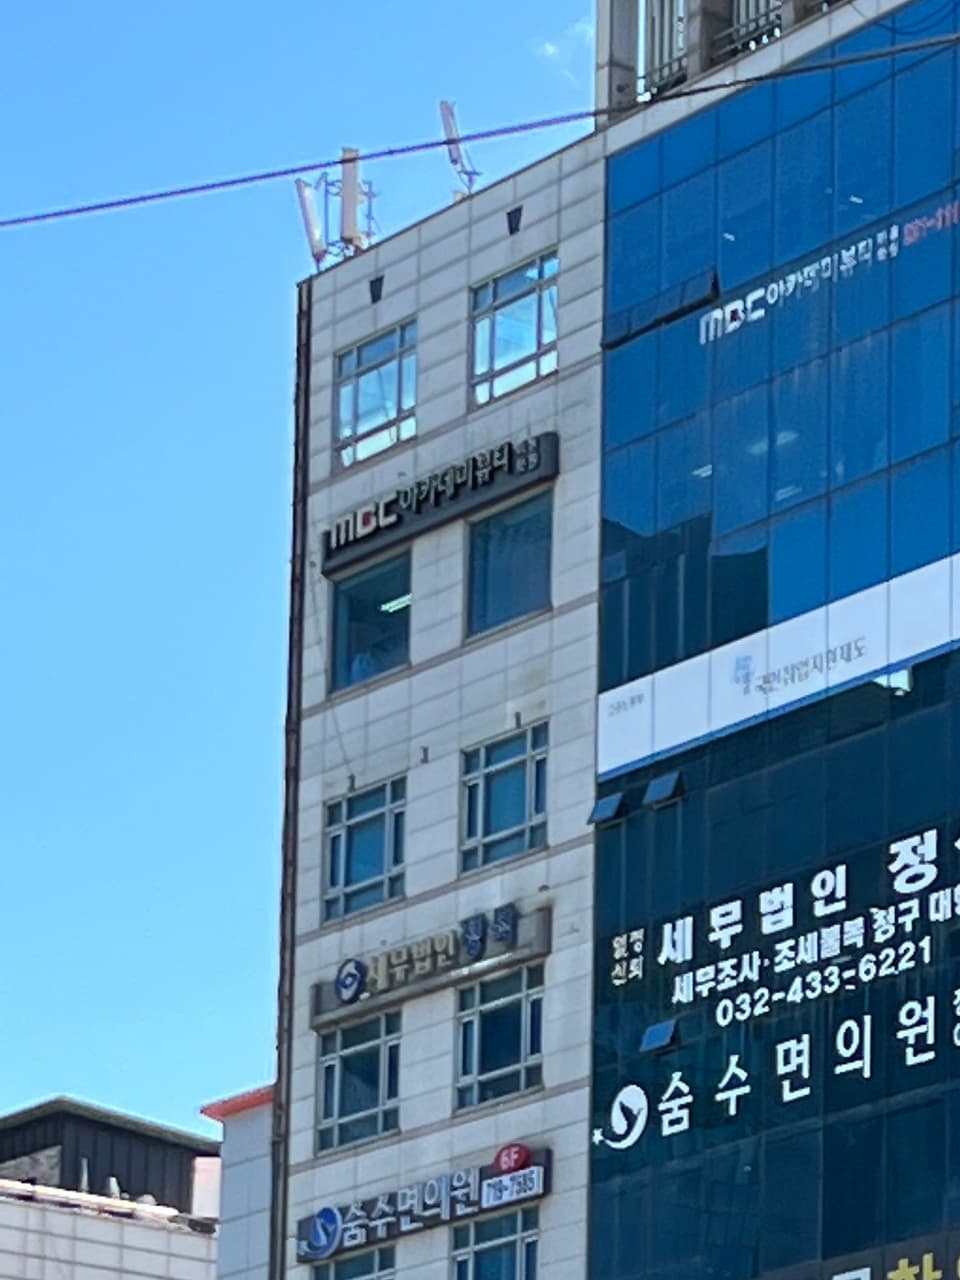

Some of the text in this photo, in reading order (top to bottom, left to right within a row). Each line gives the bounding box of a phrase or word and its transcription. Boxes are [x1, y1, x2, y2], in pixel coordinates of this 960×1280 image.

[657, 864, 847, 965] 세무법인
[715, 936, 933, 1027] 032-433-6221
[657, 996, 936, 1137] 숨수면의원
[341, 1167, 480, 1247] 숨수면의원
